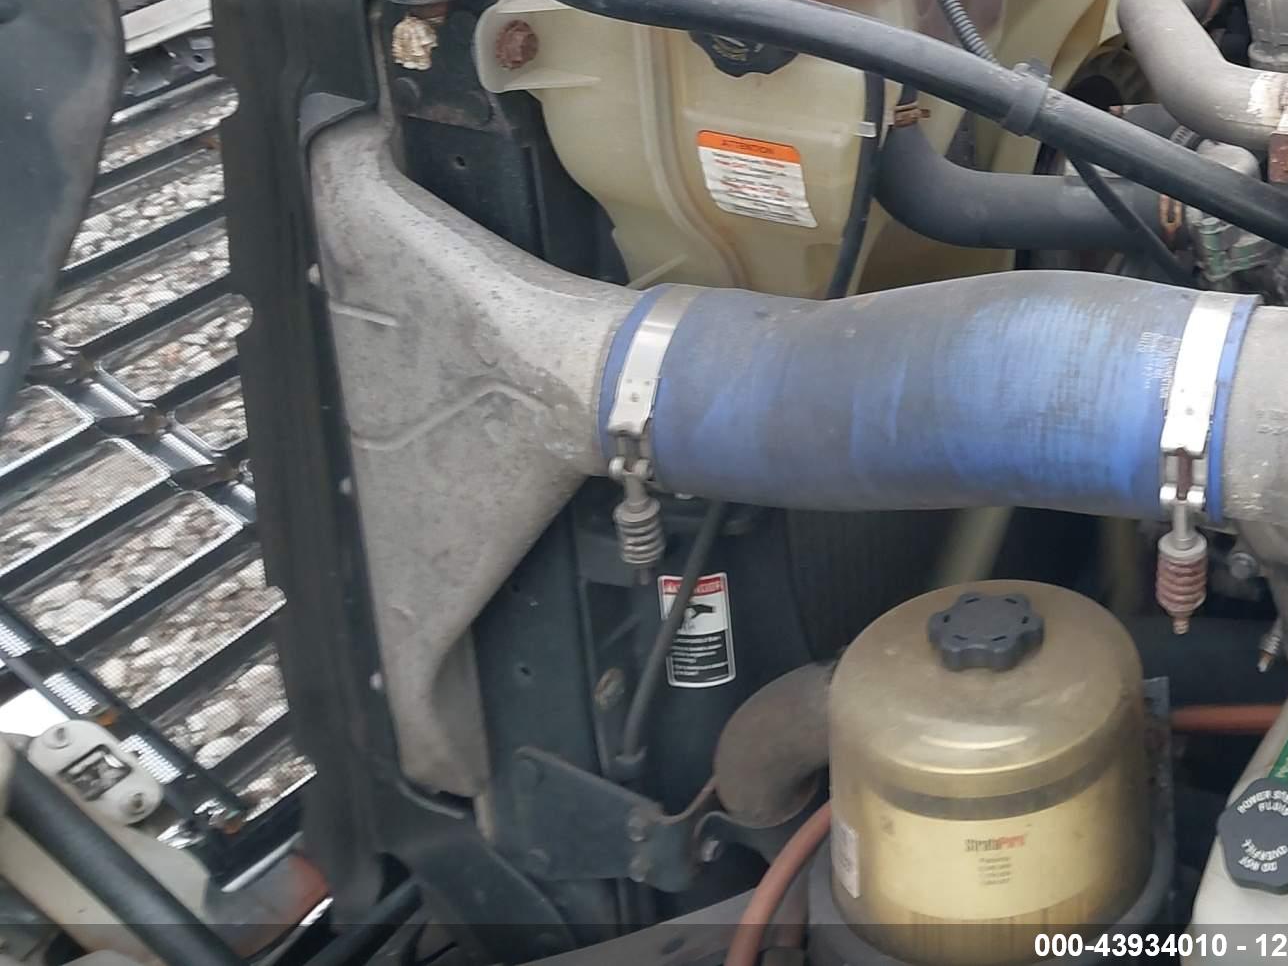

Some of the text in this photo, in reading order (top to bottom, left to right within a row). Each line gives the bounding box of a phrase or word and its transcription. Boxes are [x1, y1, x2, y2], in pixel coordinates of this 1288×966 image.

[1237, 789, 1272, 814] POWER
[1241, 838, 1288, 861] OVERFILL
[1238, 856, 1278, 872] DO NOT
